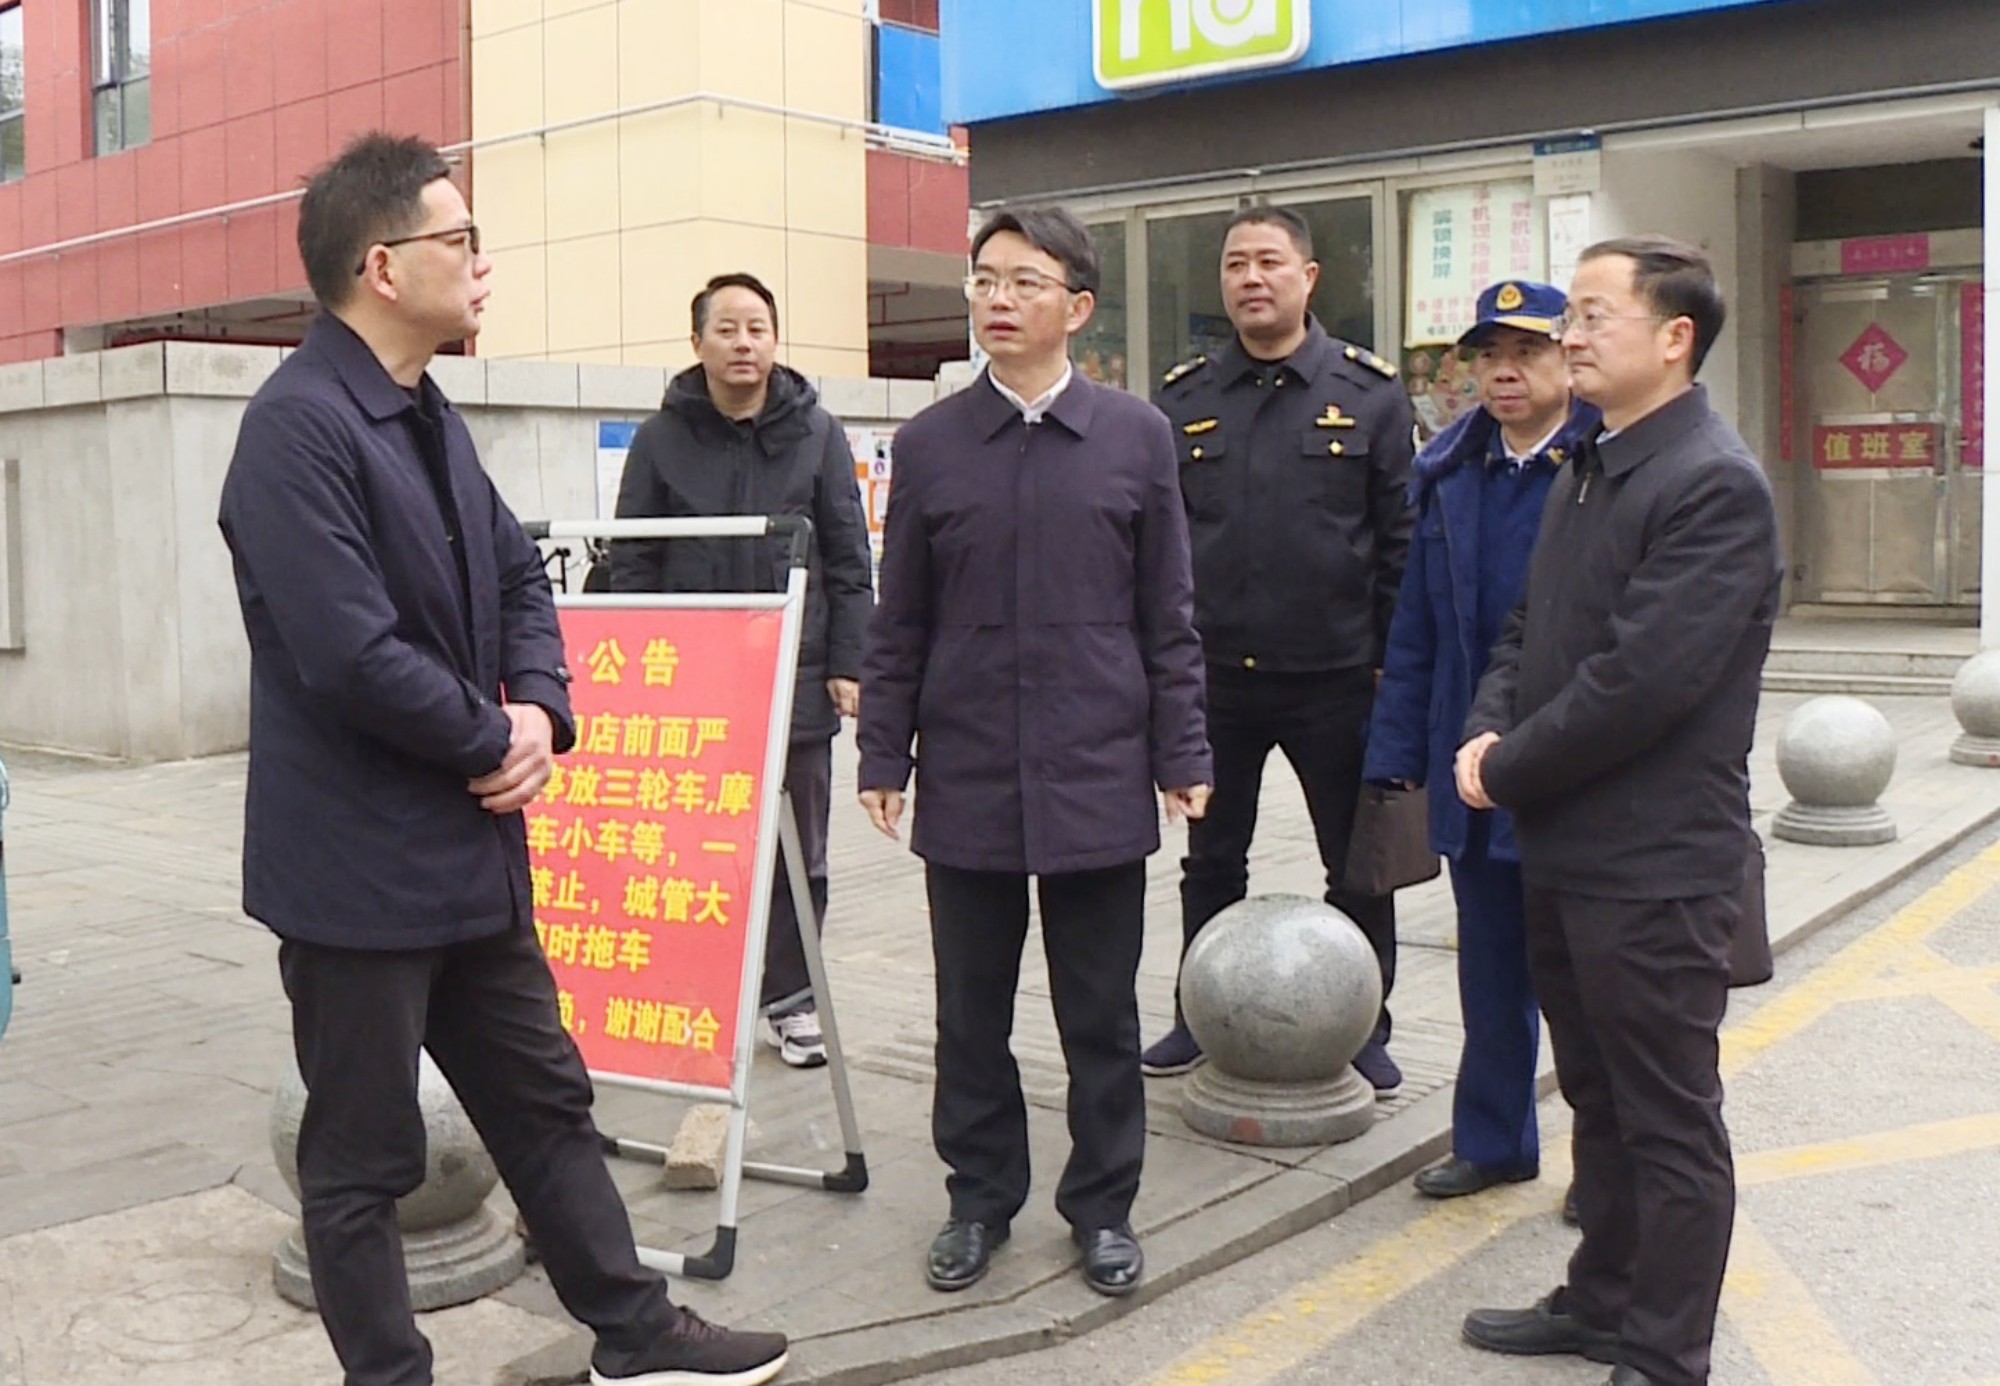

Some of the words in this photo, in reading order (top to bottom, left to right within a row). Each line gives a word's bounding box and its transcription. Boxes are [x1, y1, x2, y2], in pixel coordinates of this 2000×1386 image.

[1857, 342, 1891, 373] 福
[1823, 433, 1929, 461] 值班室
[587, 638, 679, 687] 公告
